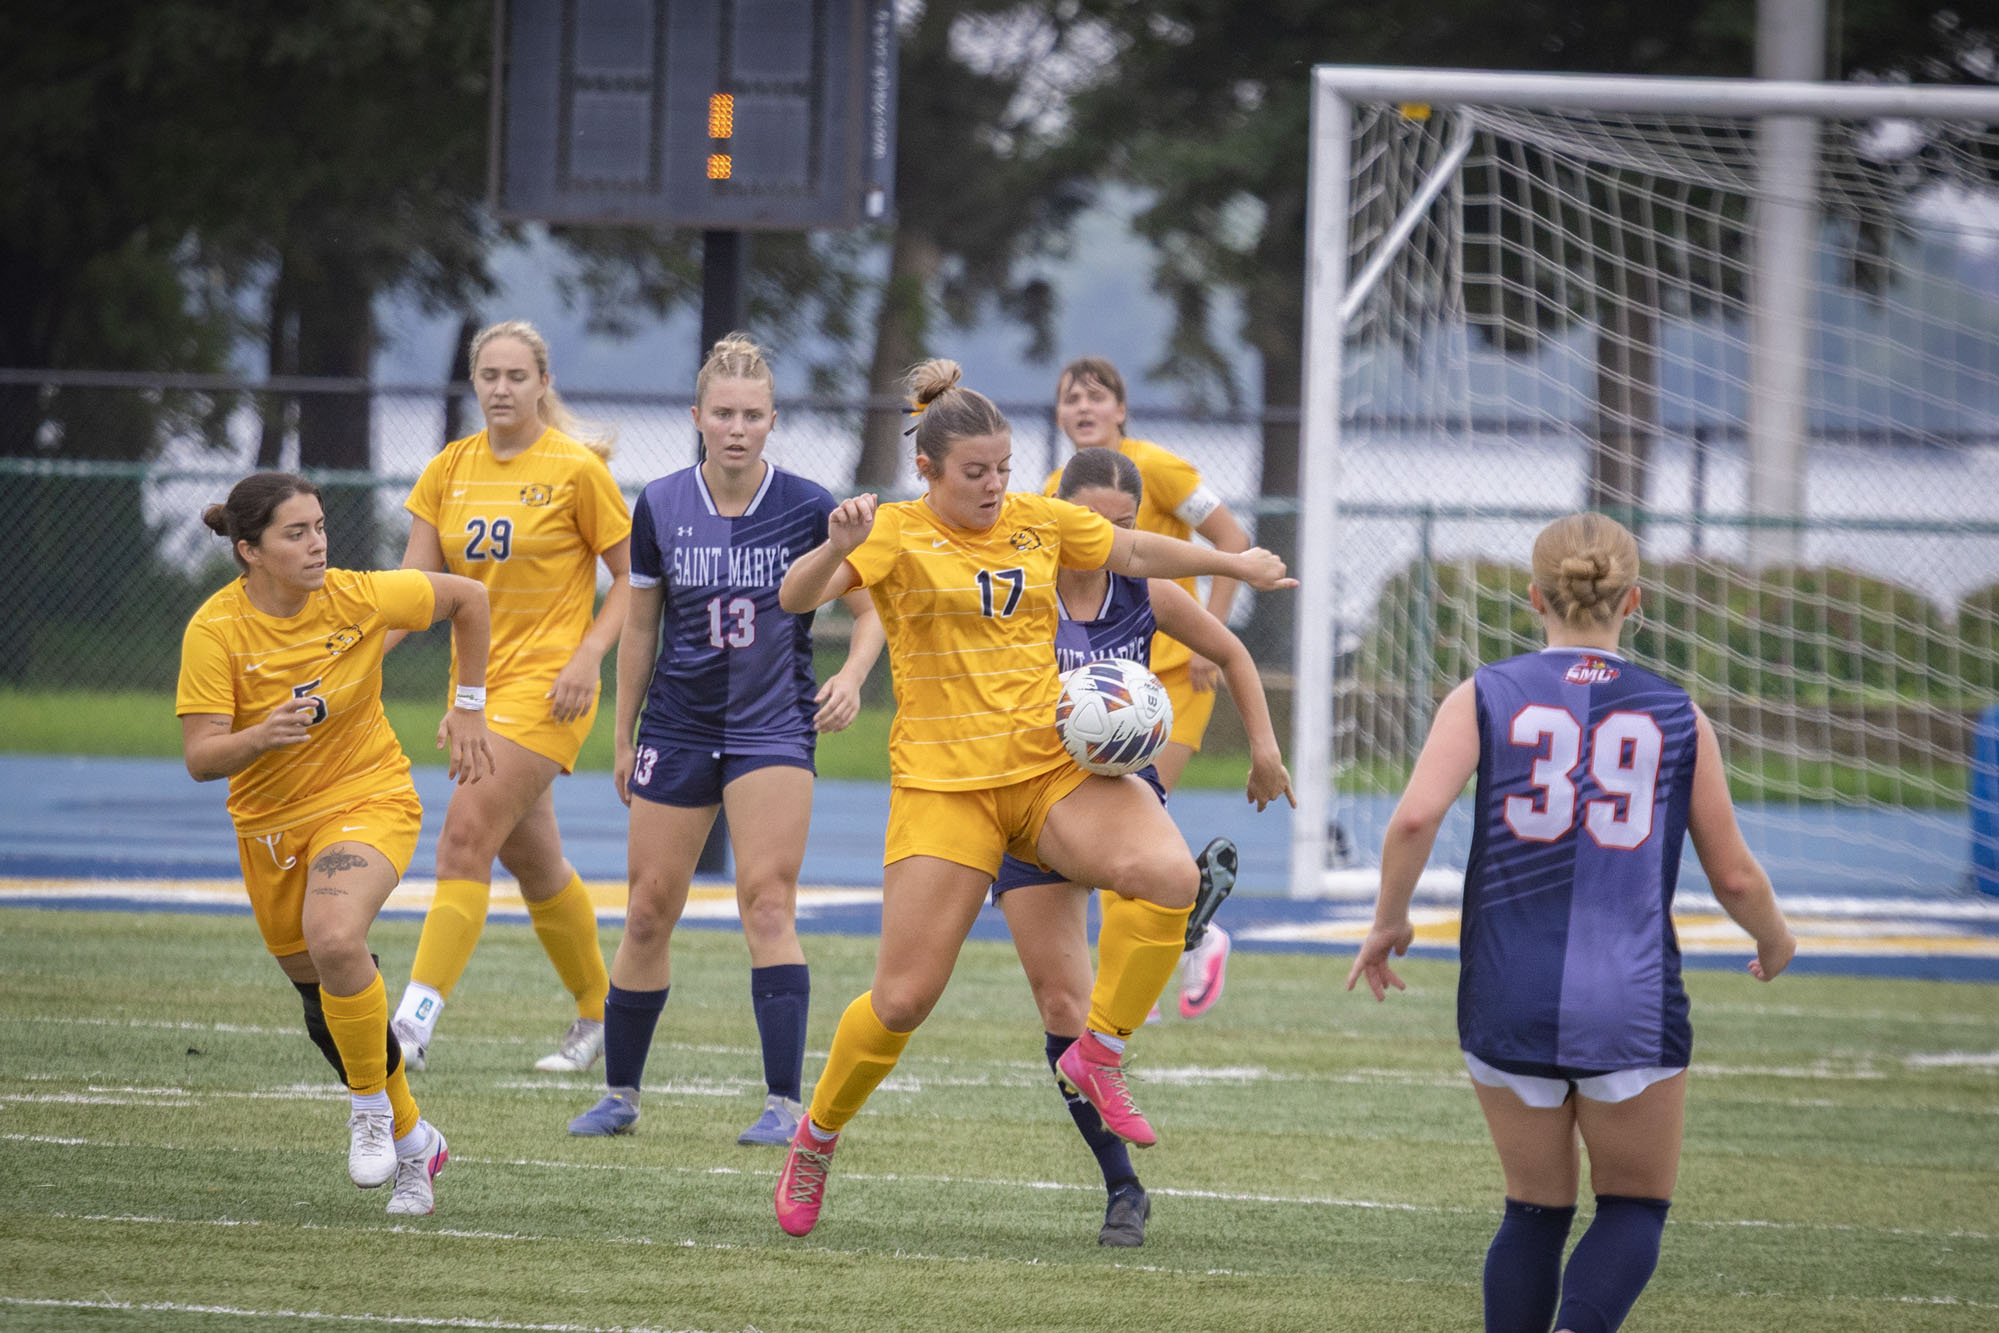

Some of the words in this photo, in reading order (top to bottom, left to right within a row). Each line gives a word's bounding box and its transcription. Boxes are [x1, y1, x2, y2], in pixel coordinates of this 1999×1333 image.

[464, 517, 515, 563] 29
[674, 546, 722, 587] SAINT
[727, 543, 790, 588] MARY'S
[975, 567, 1026, 619] 17
[707, 597, 756, 650] 13
[291, 676, 329, 728] 5
[634, 743, 659, 787] 13
[1503, 702, 1665, 851] 39
